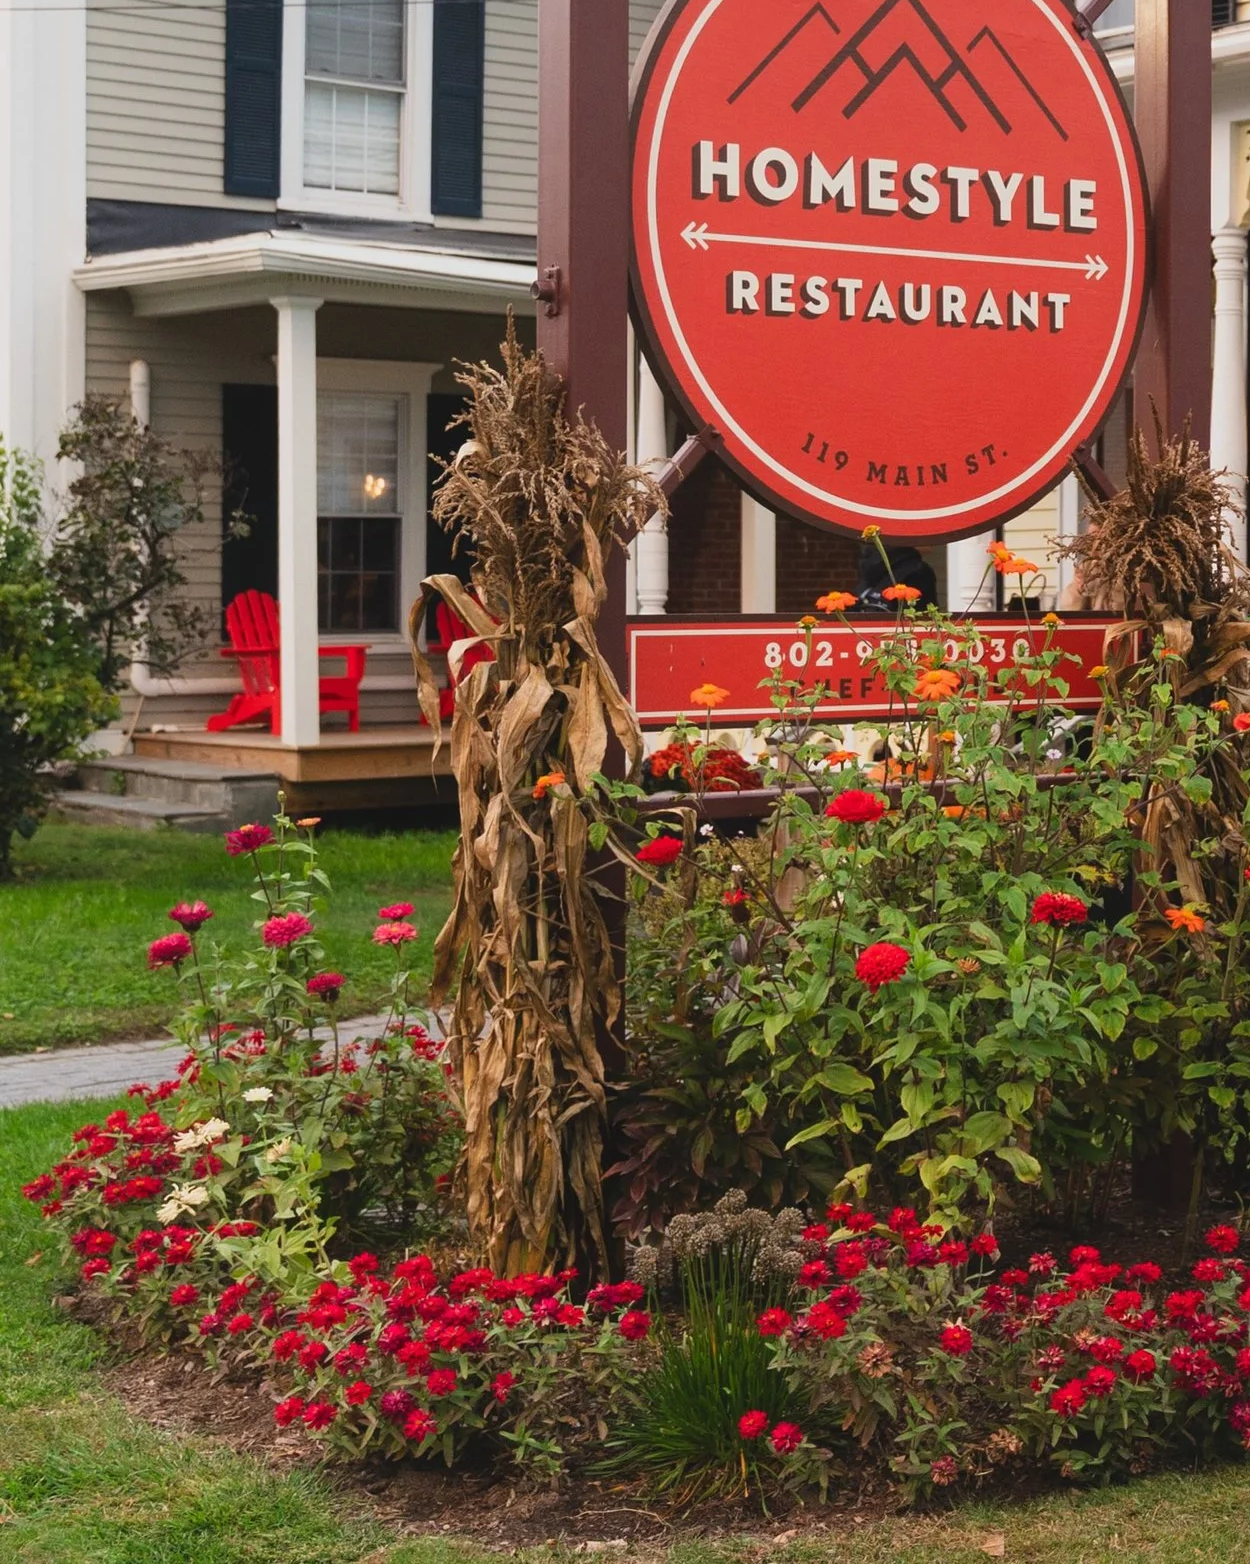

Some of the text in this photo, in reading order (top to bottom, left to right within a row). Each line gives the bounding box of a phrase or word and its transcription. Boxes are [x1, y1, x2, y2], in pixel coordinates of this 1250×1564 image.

[693, 140, 1098, 234] HOMESTYLE
[726, 270, 1071, 332] RESTAURANT
[801, 432, 1008, 486] 119 MAIN ST.
